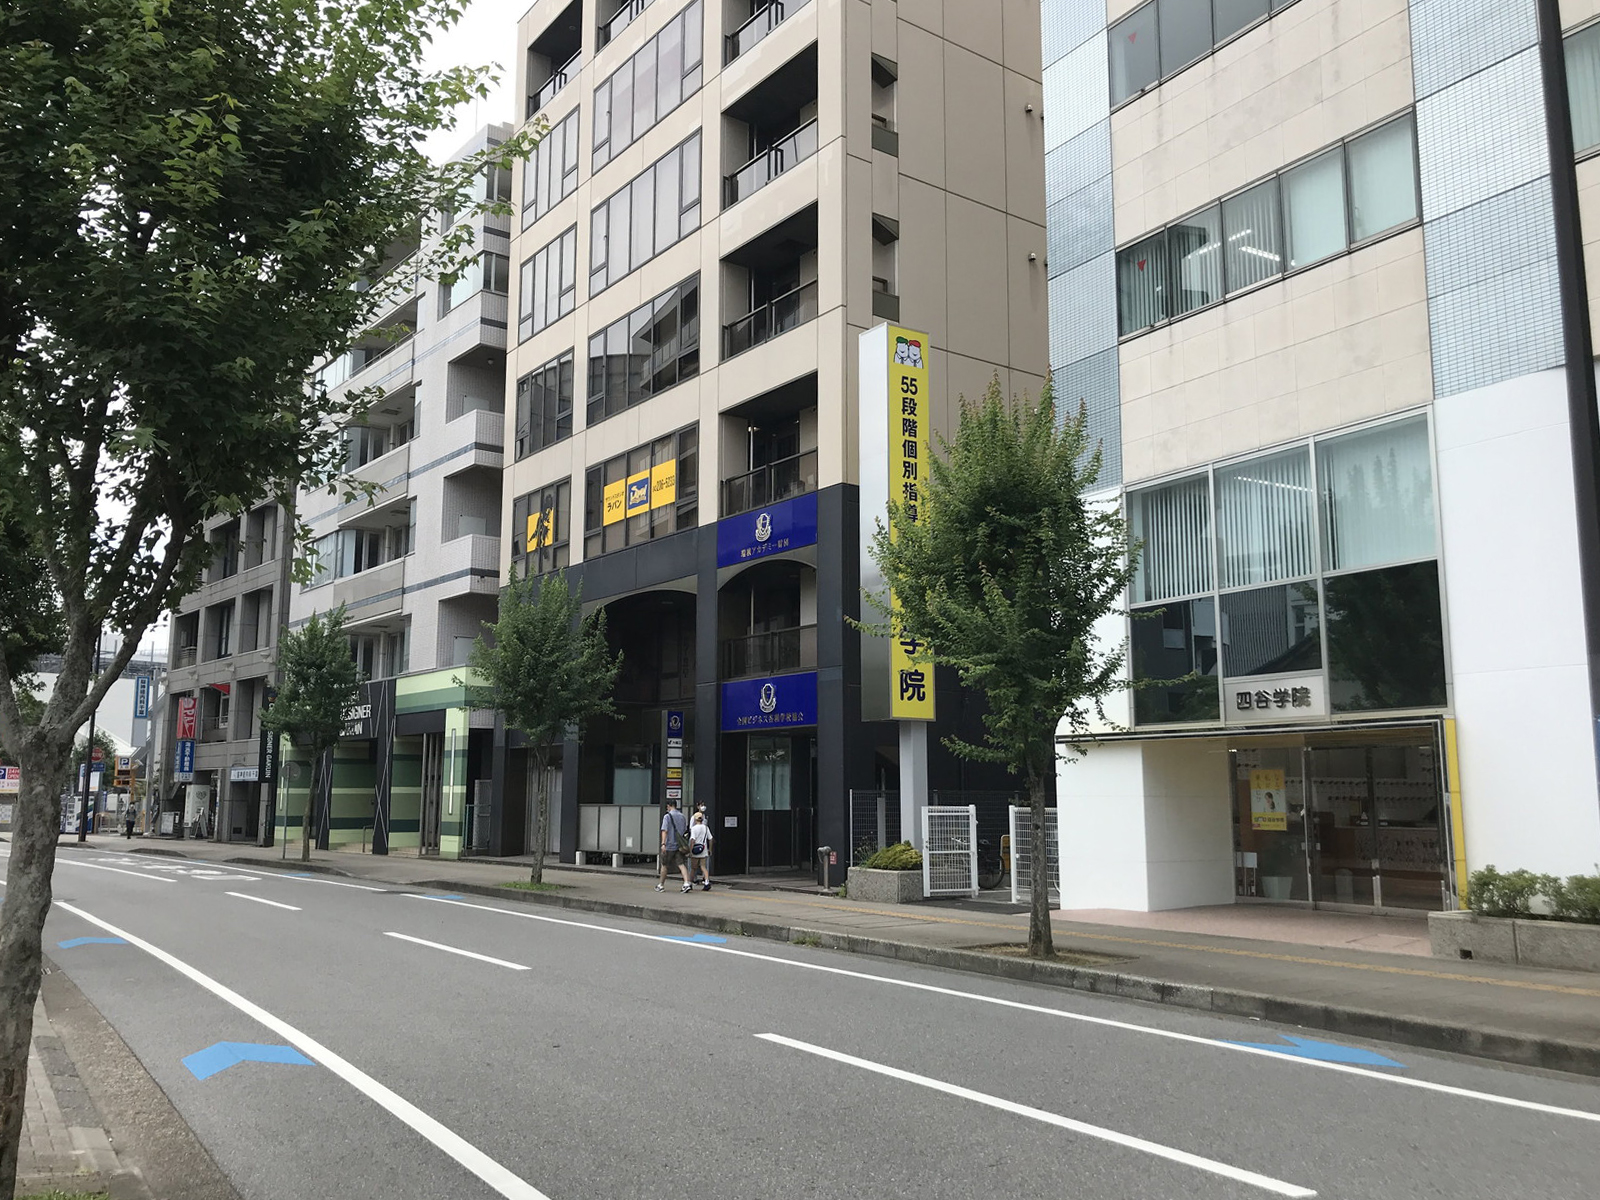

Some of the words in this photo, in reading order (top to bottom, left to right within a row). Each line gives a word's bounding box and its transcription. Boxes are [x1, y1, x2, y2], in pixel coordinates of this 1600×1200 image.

[607, 500, 622, 513] ラパン
[1236, 686, 1311, 710] 四谷学院
